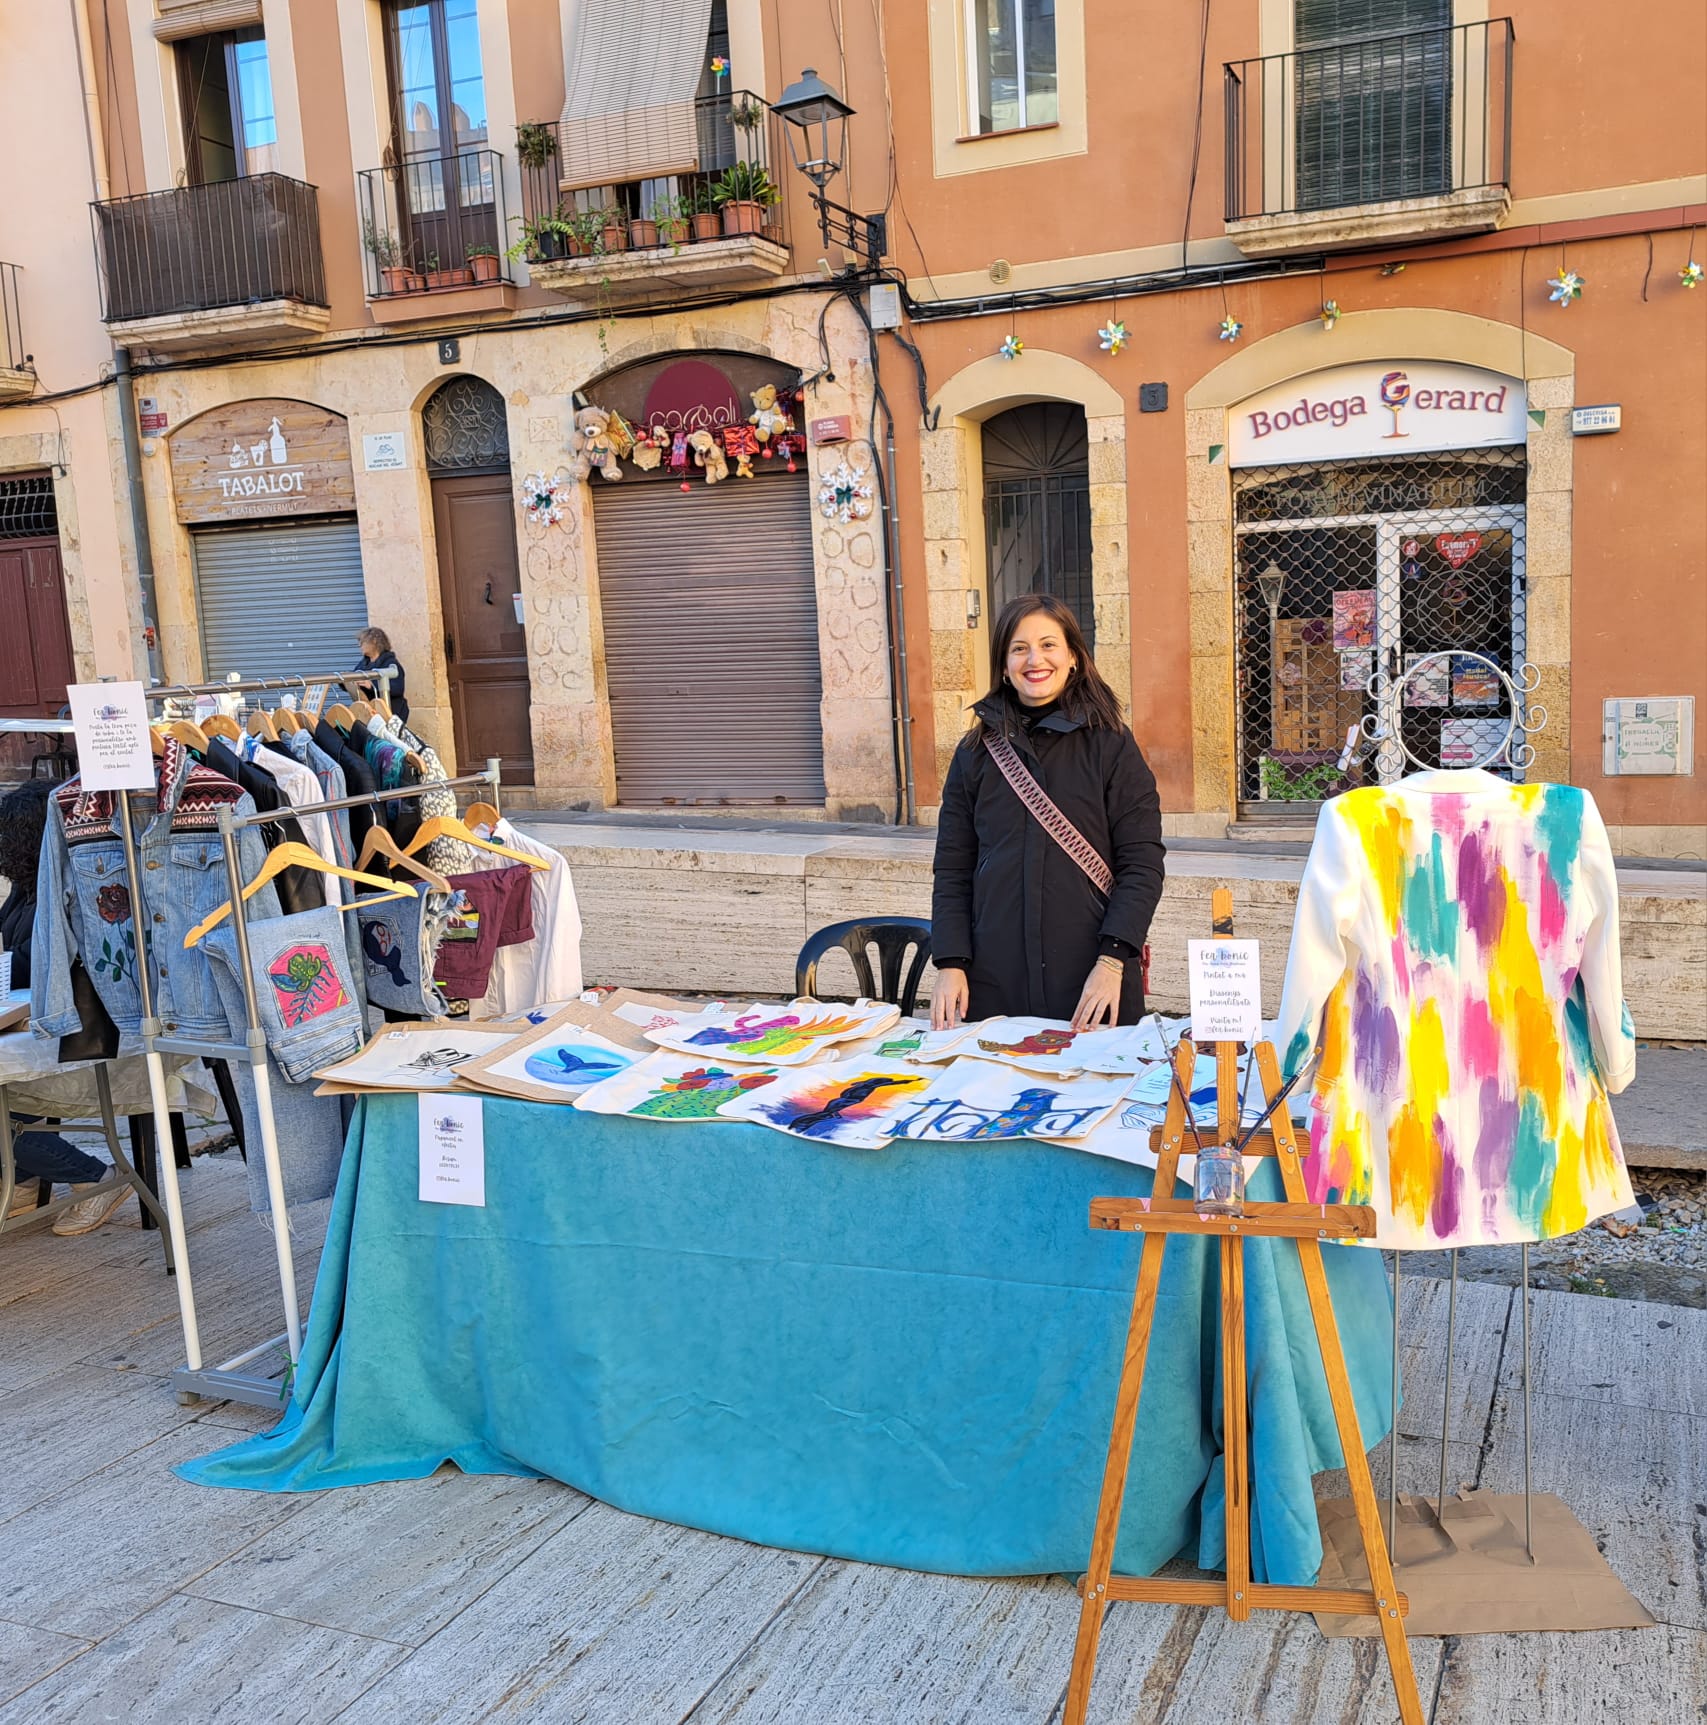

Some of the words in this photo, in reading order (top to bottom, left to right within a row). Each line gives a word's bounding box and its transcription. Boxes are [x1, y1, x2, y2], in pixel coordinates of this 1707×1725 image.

[444, 343, 453, 359] 5
[1248, 394, 1368, 439] Bodega
[1380, 372, 1507, 414] Gerard
[218, 471, 305, 498] TABALOT
[267, 502, 298, 513] VERMUT
[1220, 949, 1249, 961] bonic
[1203, 971, 1226, 979] Pintat
[1209, 989, 1241, 998] Dissenys
